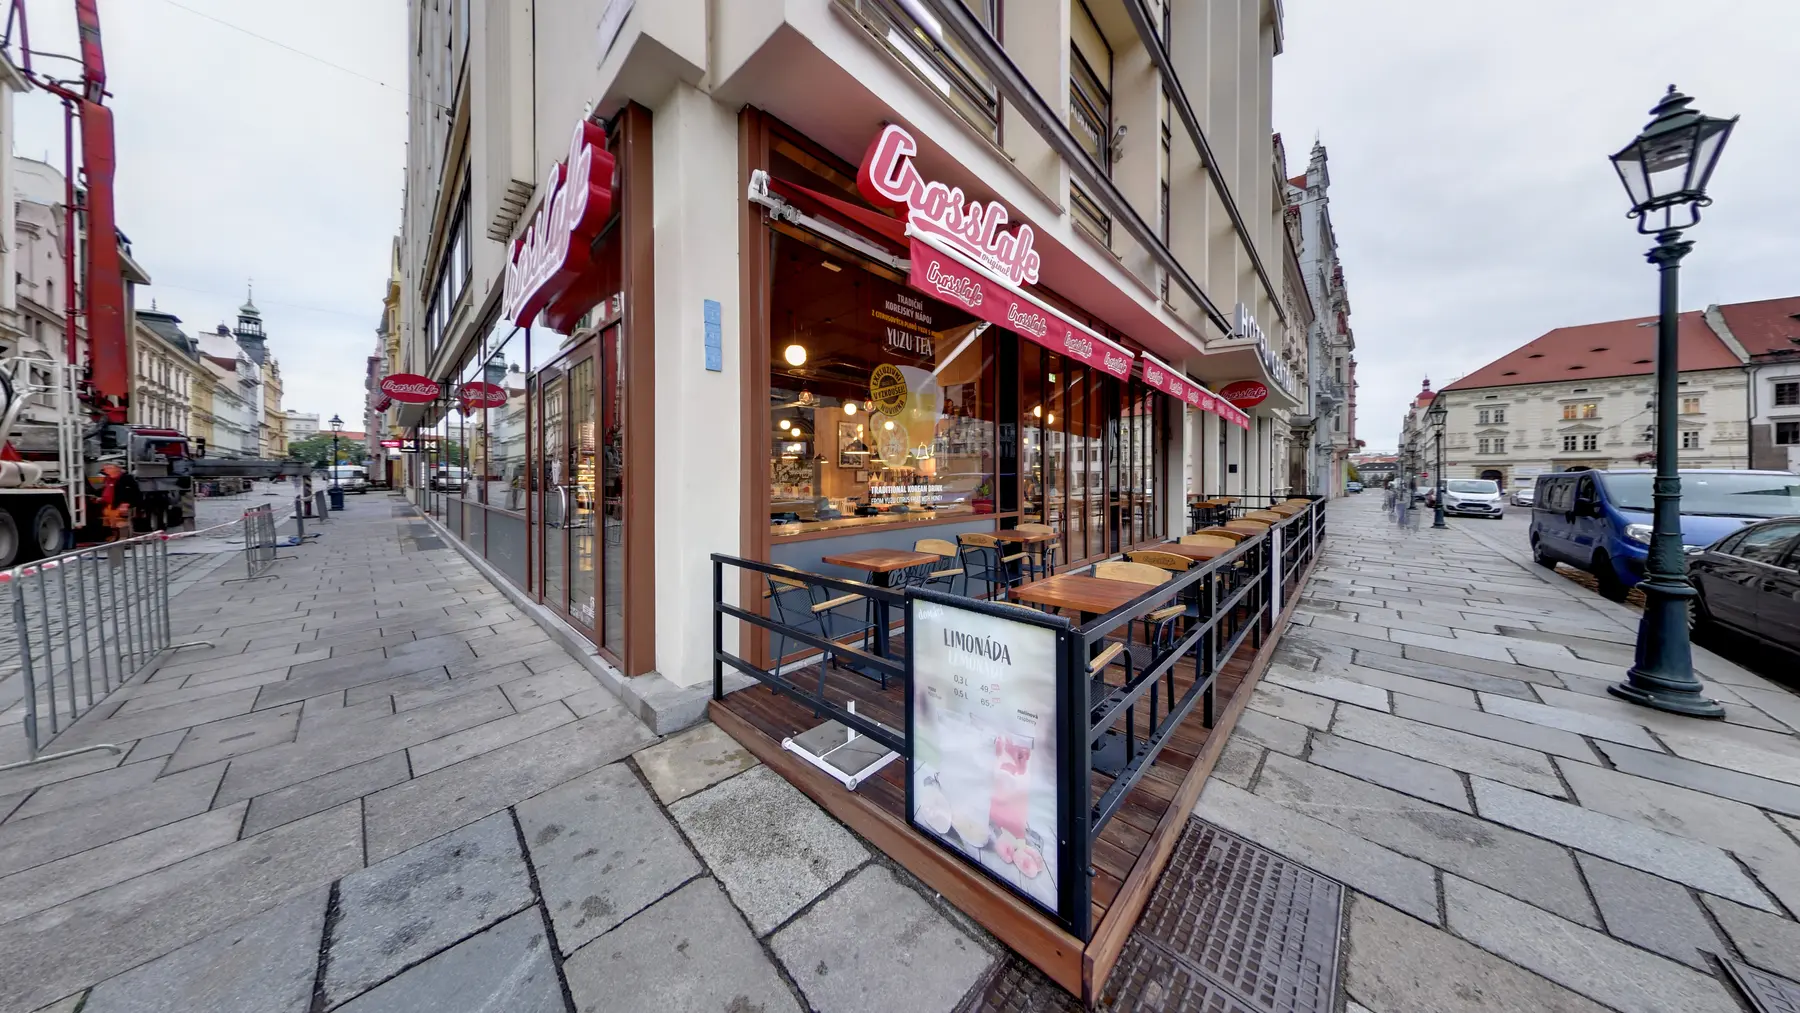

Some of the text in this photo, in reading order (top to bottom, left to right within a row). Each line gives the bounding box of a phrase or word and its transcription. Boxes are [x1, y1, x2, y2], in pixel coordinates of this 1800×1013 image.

[870, 125, 1040, 286] CrossCafe
[981, 253, 1011, 277] original
[927, 261, 983, 307] CrossCafe
[885, 300, 932, 325] KOREJSKÝ NÁPOJ
[897, 294, 923, 311] TRADIČNÍ
[1008, 303, 1047, 337] CrossCafe
[886, 326, 932, 357] YUZU TEA
[381, 380, 439, 395] CrossCafe
[871, 485, 906, 494] TRADITIONAL
[907, 484, 927, 493] KOREAN
[943, 628, 1012, 666] LIMONÁDA
